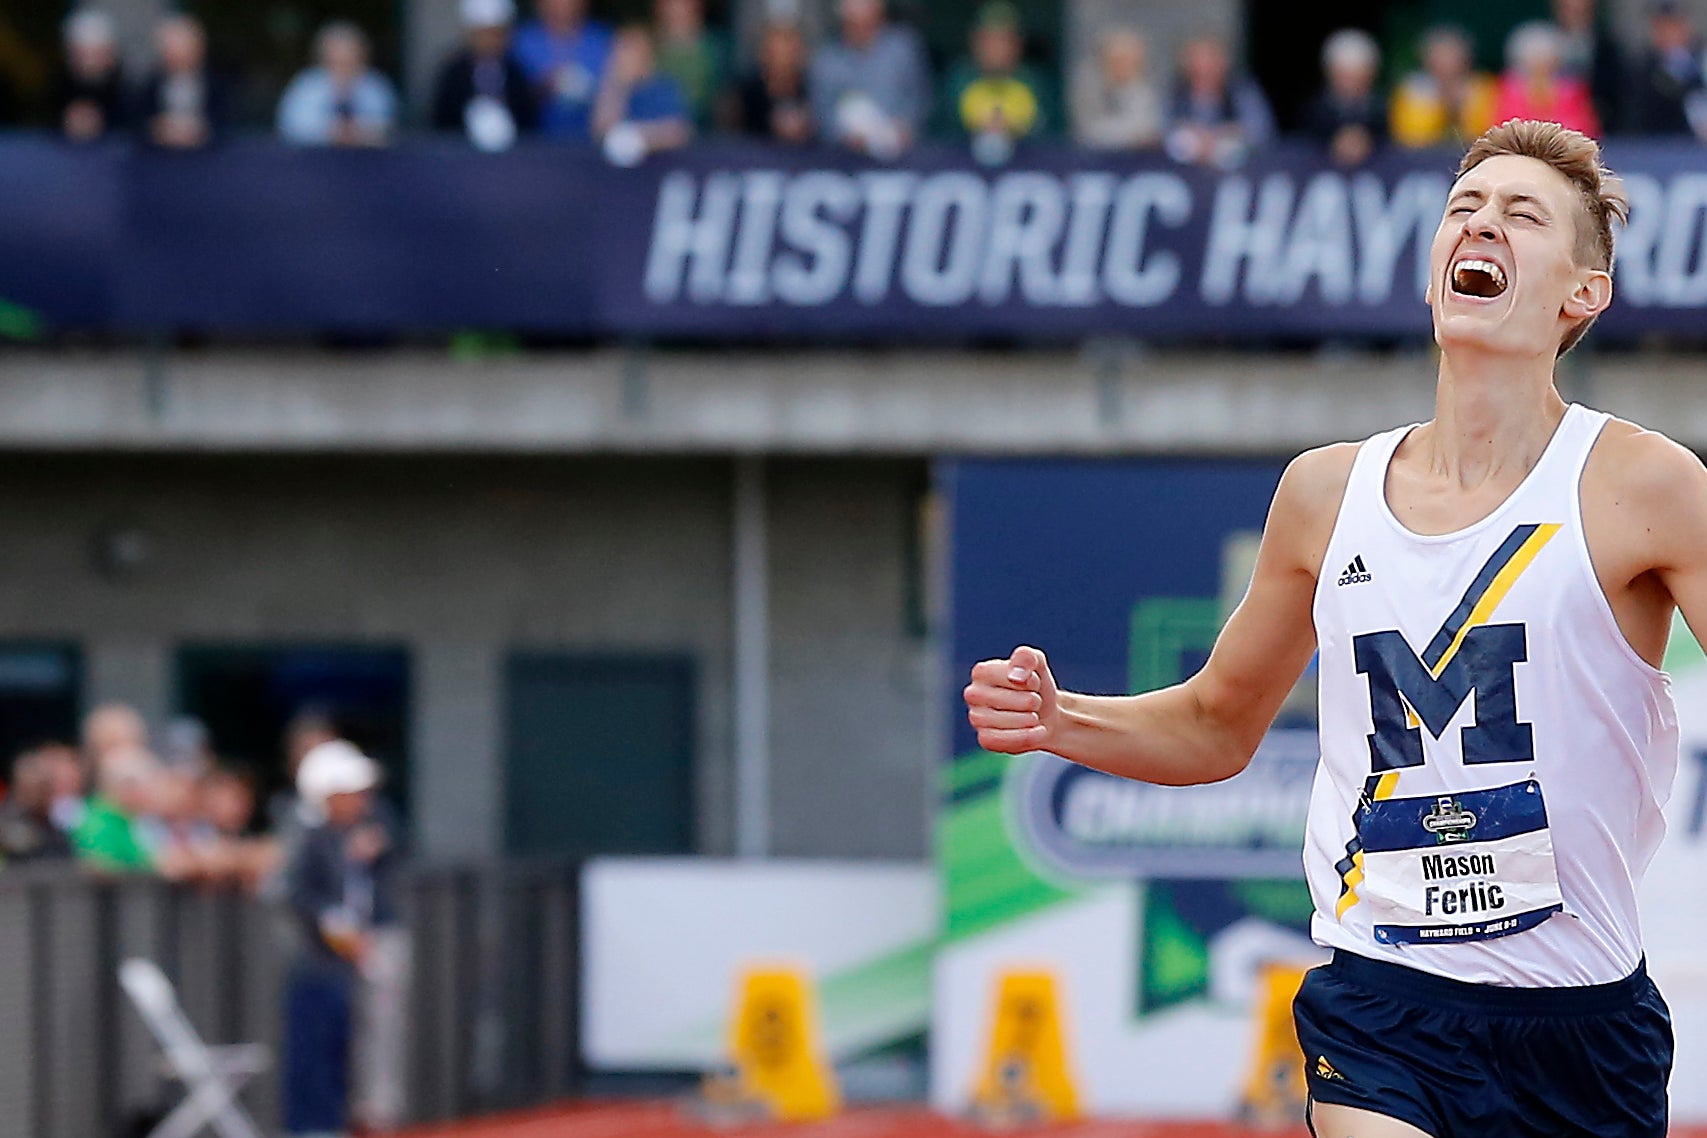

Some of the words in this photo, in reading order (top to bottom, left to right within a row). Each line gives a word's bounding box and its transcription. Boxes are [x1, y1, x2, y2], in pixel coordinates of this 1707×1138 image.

[644, 170, 1192, 305] HISTORIC
[1338, 573, 1372, 587] adidas
[1352, 622, 1535, 773] M
[1421, 854, 1496, 880] Mason
[1425, 882, 1505, 916] Ferlic
